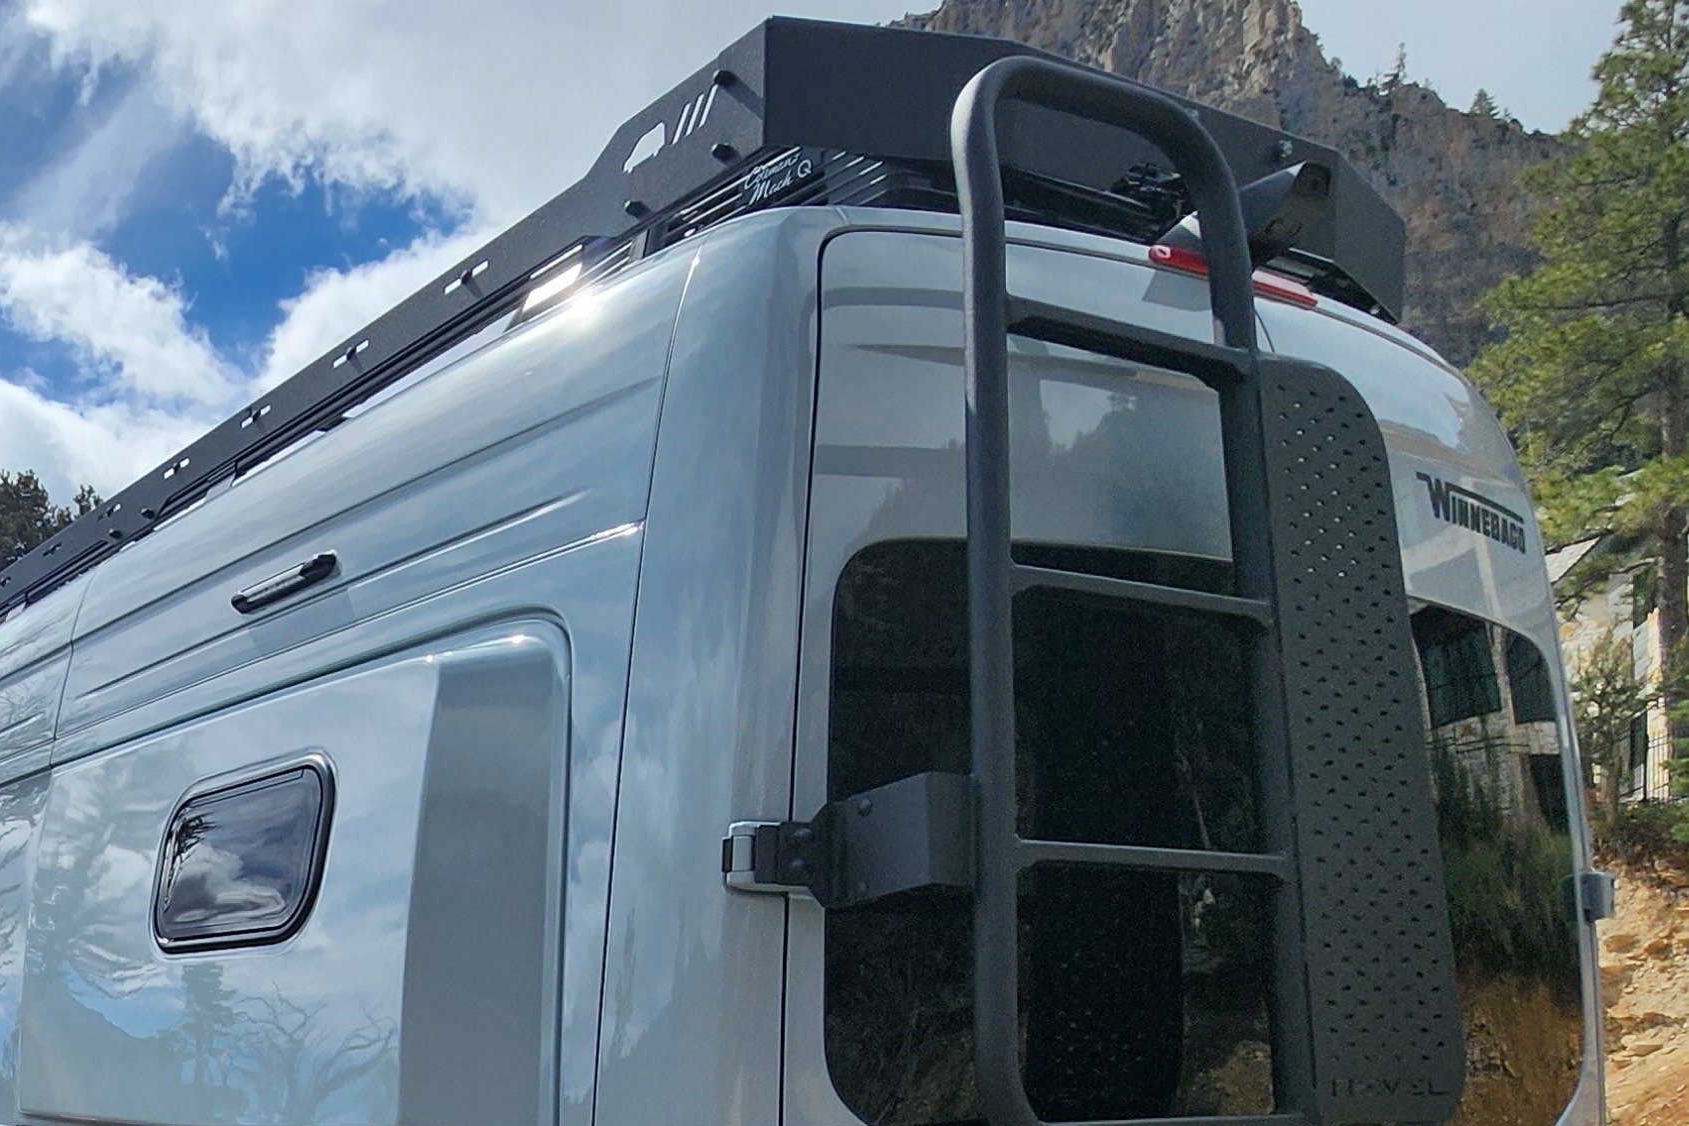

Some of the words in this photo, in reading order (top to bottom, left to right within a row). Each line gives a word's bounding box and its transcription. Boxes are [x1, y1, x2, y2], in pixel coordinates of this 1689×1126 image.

[748, 169, 794, 205] Mach
[797, 159, 812, 178] Q
[1415, 471, 1526, 554] WINNEBAGO
